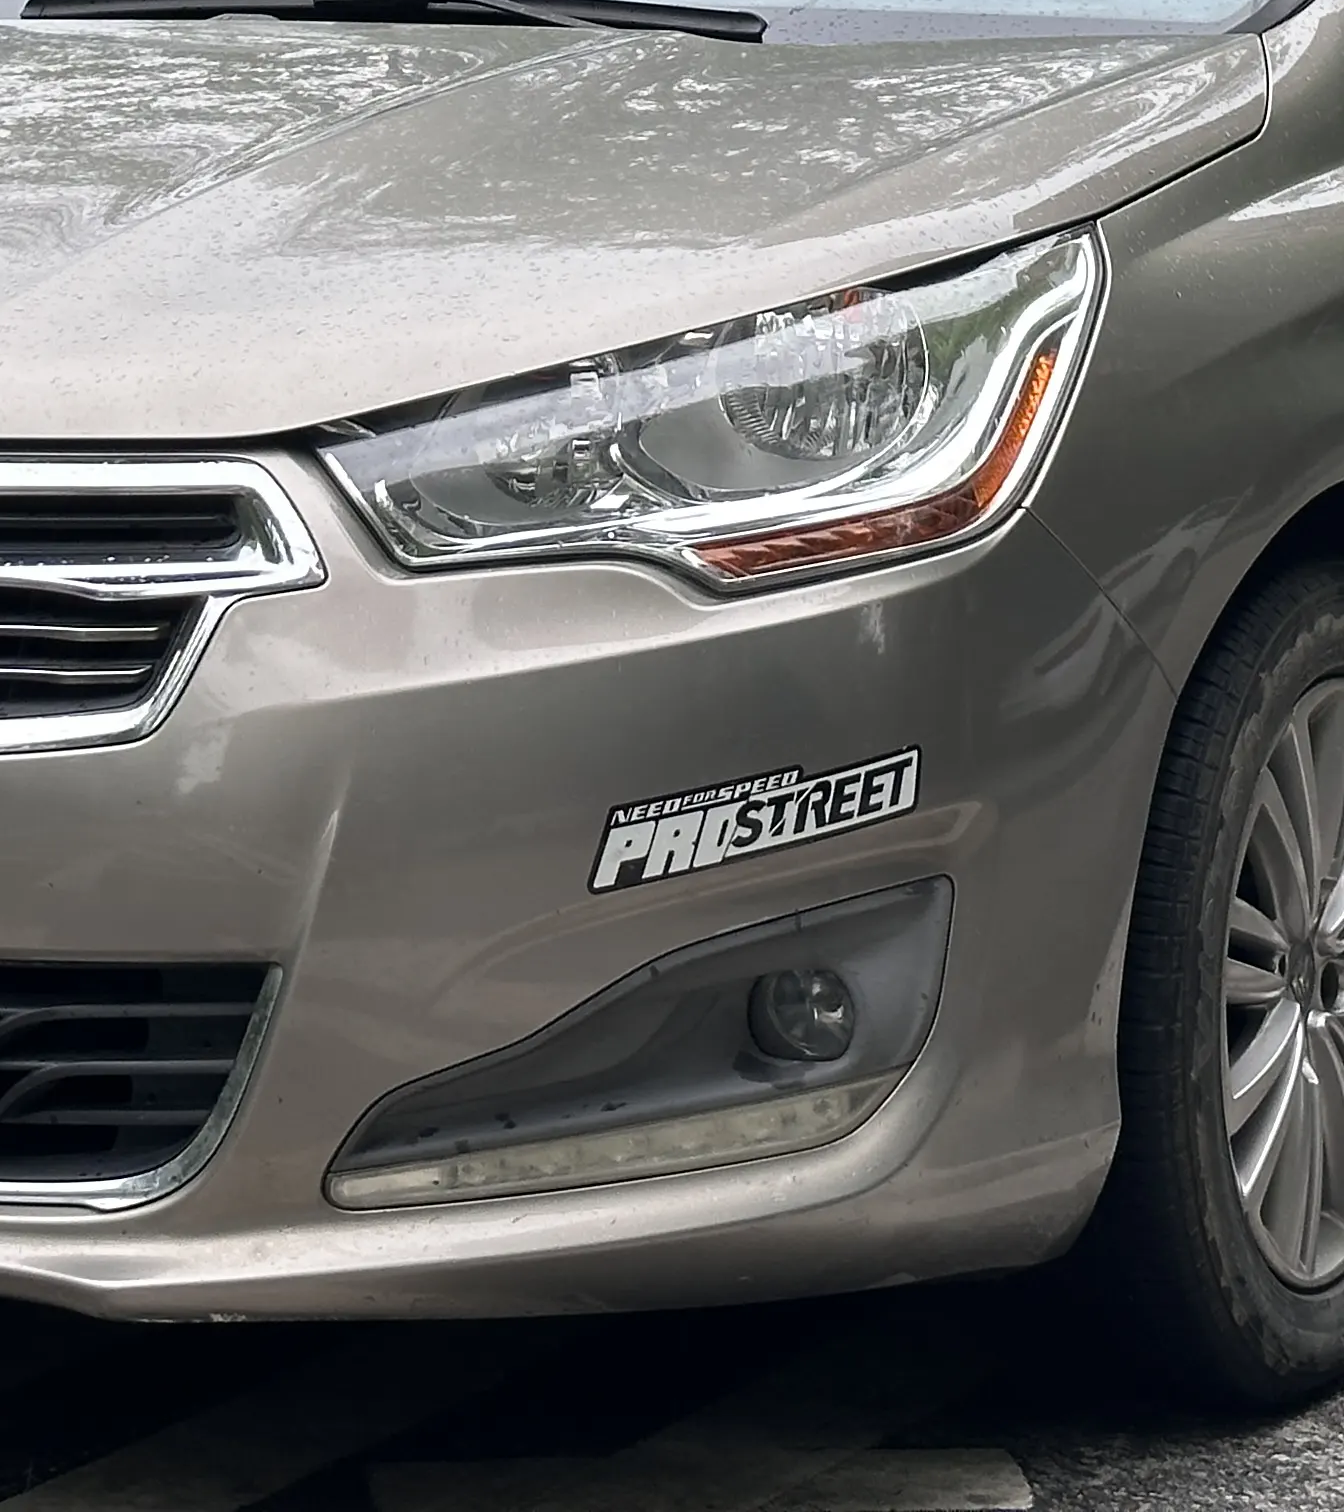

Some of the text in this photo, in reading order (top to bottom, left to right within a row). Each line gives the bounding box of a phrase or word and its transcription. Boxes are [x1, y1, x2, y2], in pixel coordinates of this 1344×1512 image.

[610, 769, 800, 826] NEED FOR SPEED
